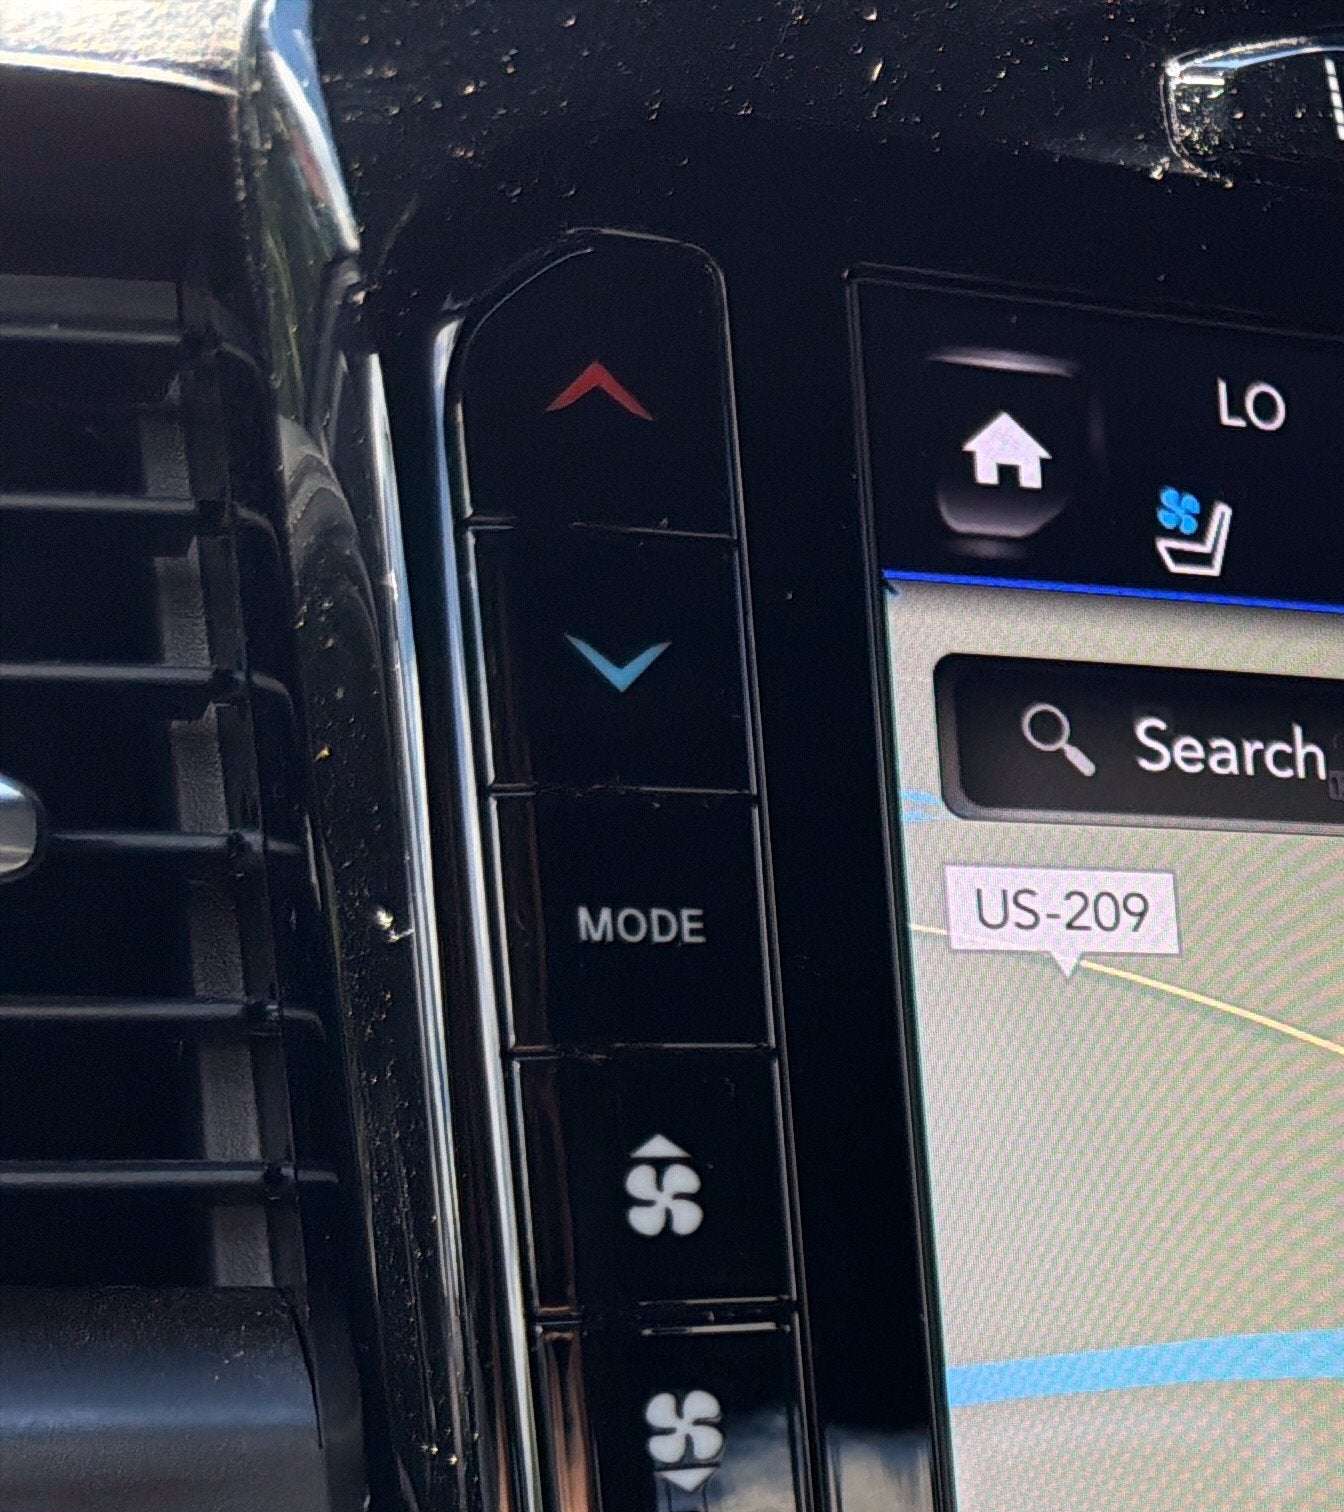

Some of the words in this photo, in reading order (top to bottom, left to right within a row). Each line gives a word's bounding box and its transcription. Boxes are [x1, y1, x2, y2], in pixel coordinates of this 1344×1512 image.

[1217, 377, 1288, 433] LO
[1134, 714, 1328, 782] Search
[577, 906, 707, 945] MODE
[975, 887, 1150, 933] US-209
